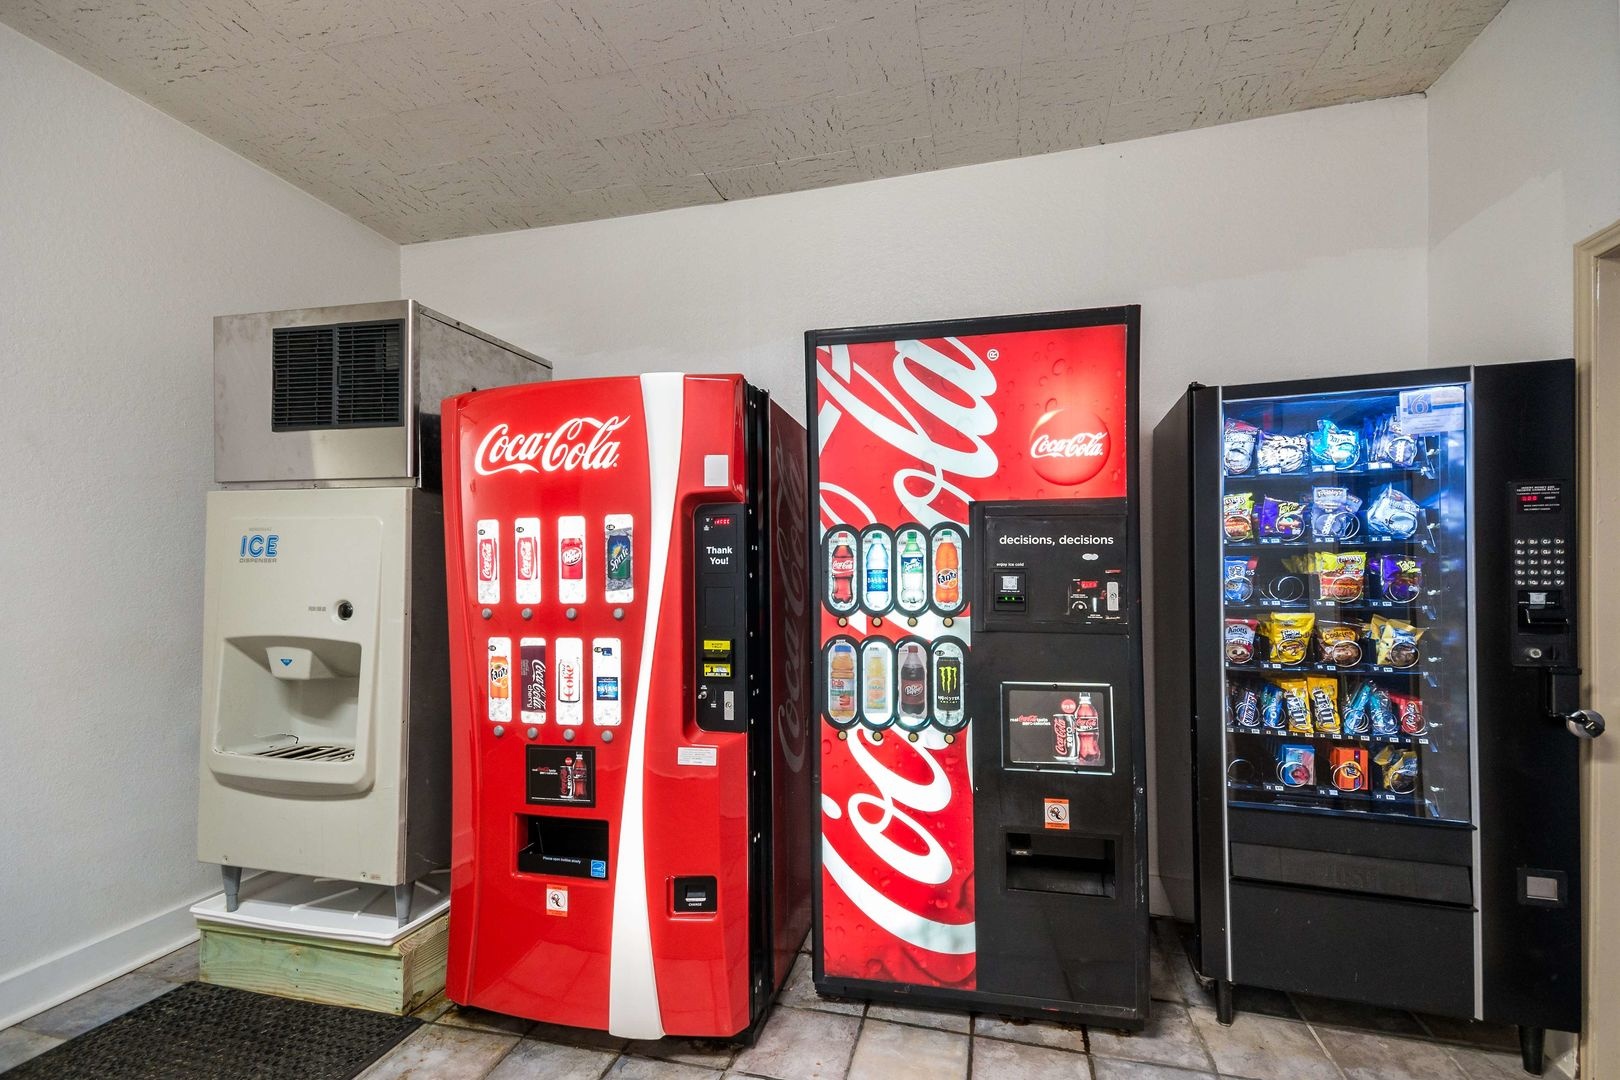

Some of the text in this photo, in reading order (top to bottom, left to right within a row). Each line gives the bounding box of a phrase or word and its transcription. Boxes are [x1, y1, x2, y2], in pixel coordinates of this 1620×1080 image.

[474, 415, 631, 476] Coca-Cola
[1030, 431, 1108, 459] Coca-Cola
[240, 534, 280, 558] ICE
[706, 546, 733, 554] Thank
[999, 534, 1114, 546] decisions, decisions
[610, 546, 629, 571] Sprite
[709, 557, 729, 565] You!
[1054, 717, 1068, 756] Coca-Cola
